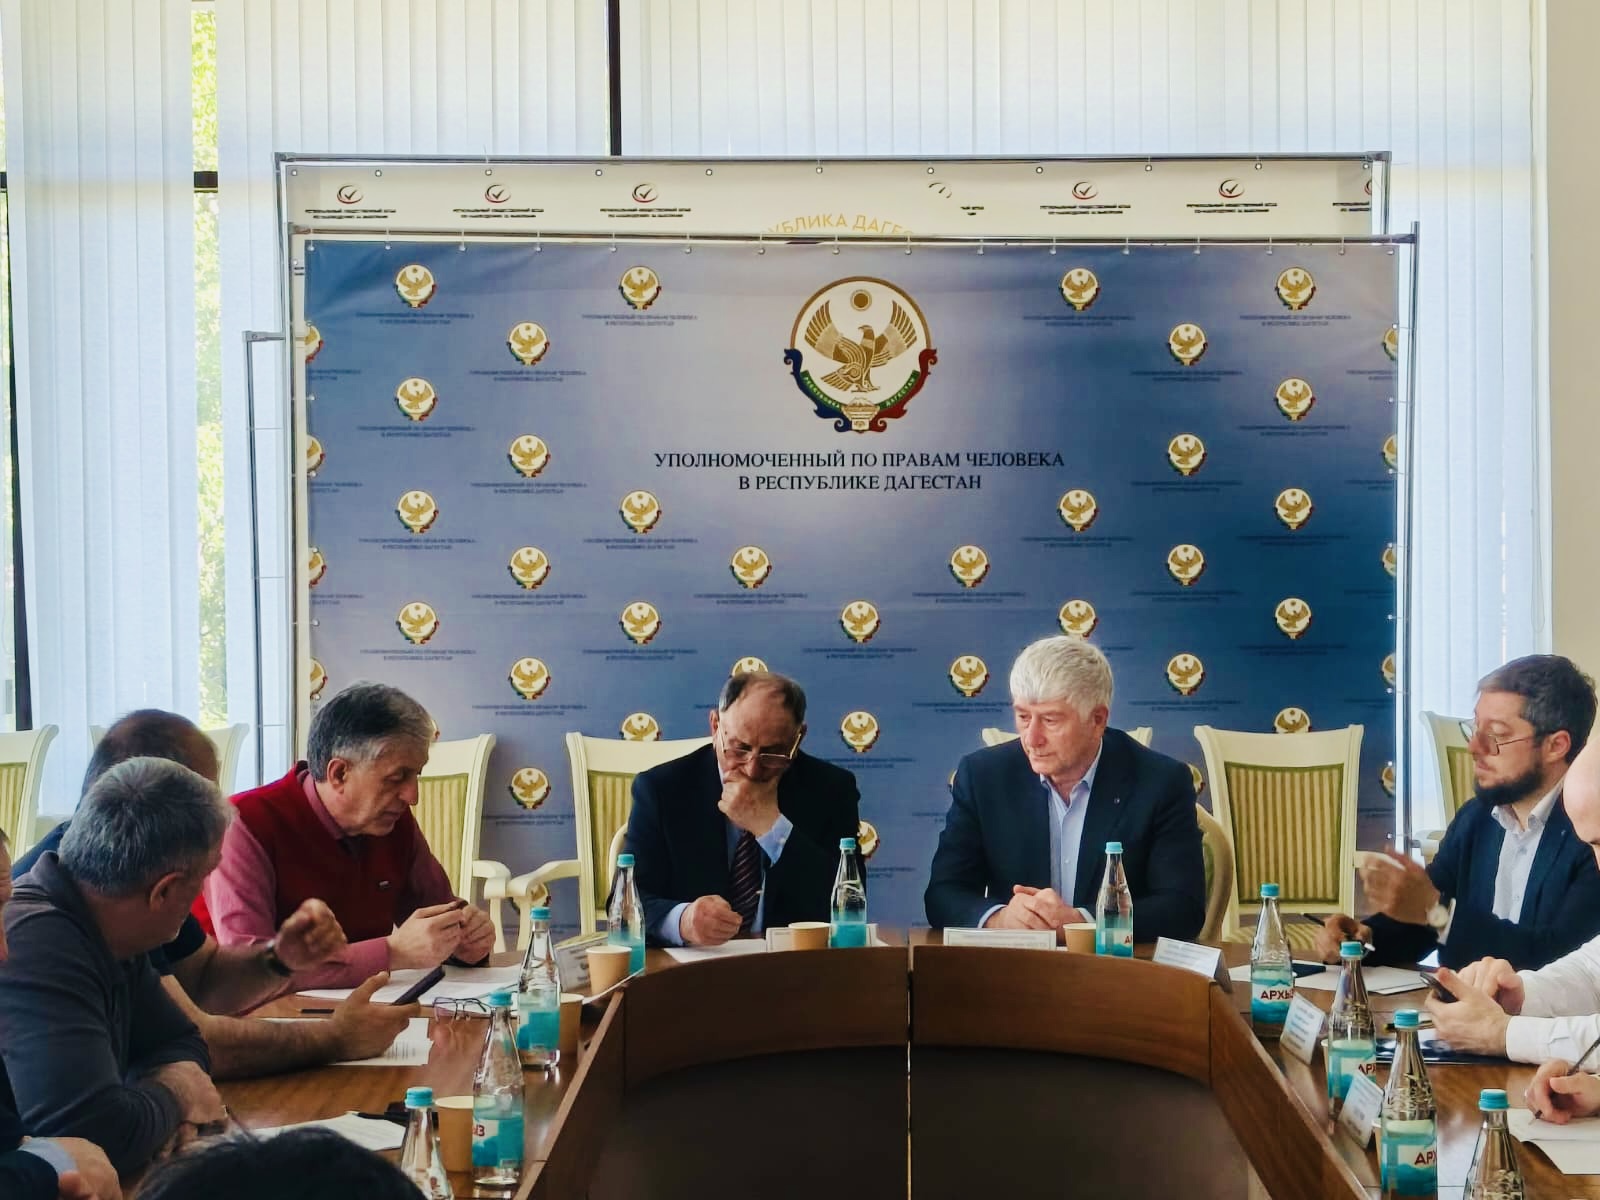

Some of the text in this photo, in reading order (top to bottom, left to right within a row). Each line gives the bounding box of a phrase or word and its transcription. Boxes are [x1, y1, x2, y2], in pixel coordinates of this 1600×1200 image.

[852, 214, 915, 234] ДАГЕ
[654, 449, 1065, 468] УПОЛНОМОЧЕННЫЙ ПО ПРАВАМ ЧЕЛОВЕКА
[738, 474, 982, 492] В РЕСПУБЛИКЕ ДАГЕСТАН
